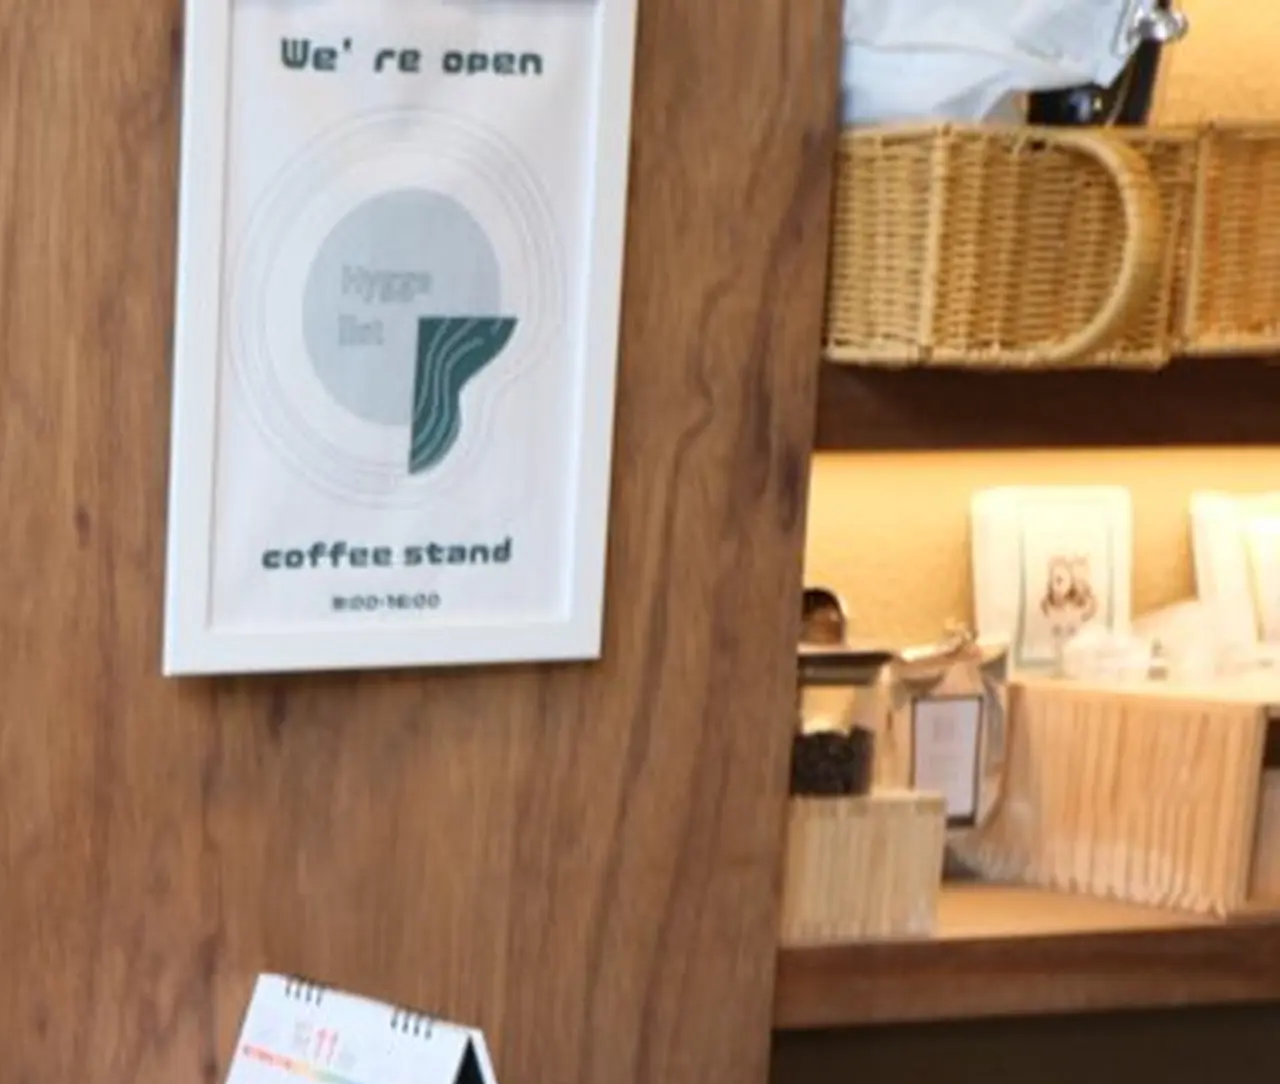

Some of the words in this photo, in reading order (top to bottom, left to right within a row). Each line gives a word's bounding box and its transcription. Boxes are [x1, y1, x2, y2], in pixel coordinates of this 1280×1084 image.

[441, 50, 544, 76] open
[260, 540, 393, 570] coffee
[402, 536, 513, 567] stand
